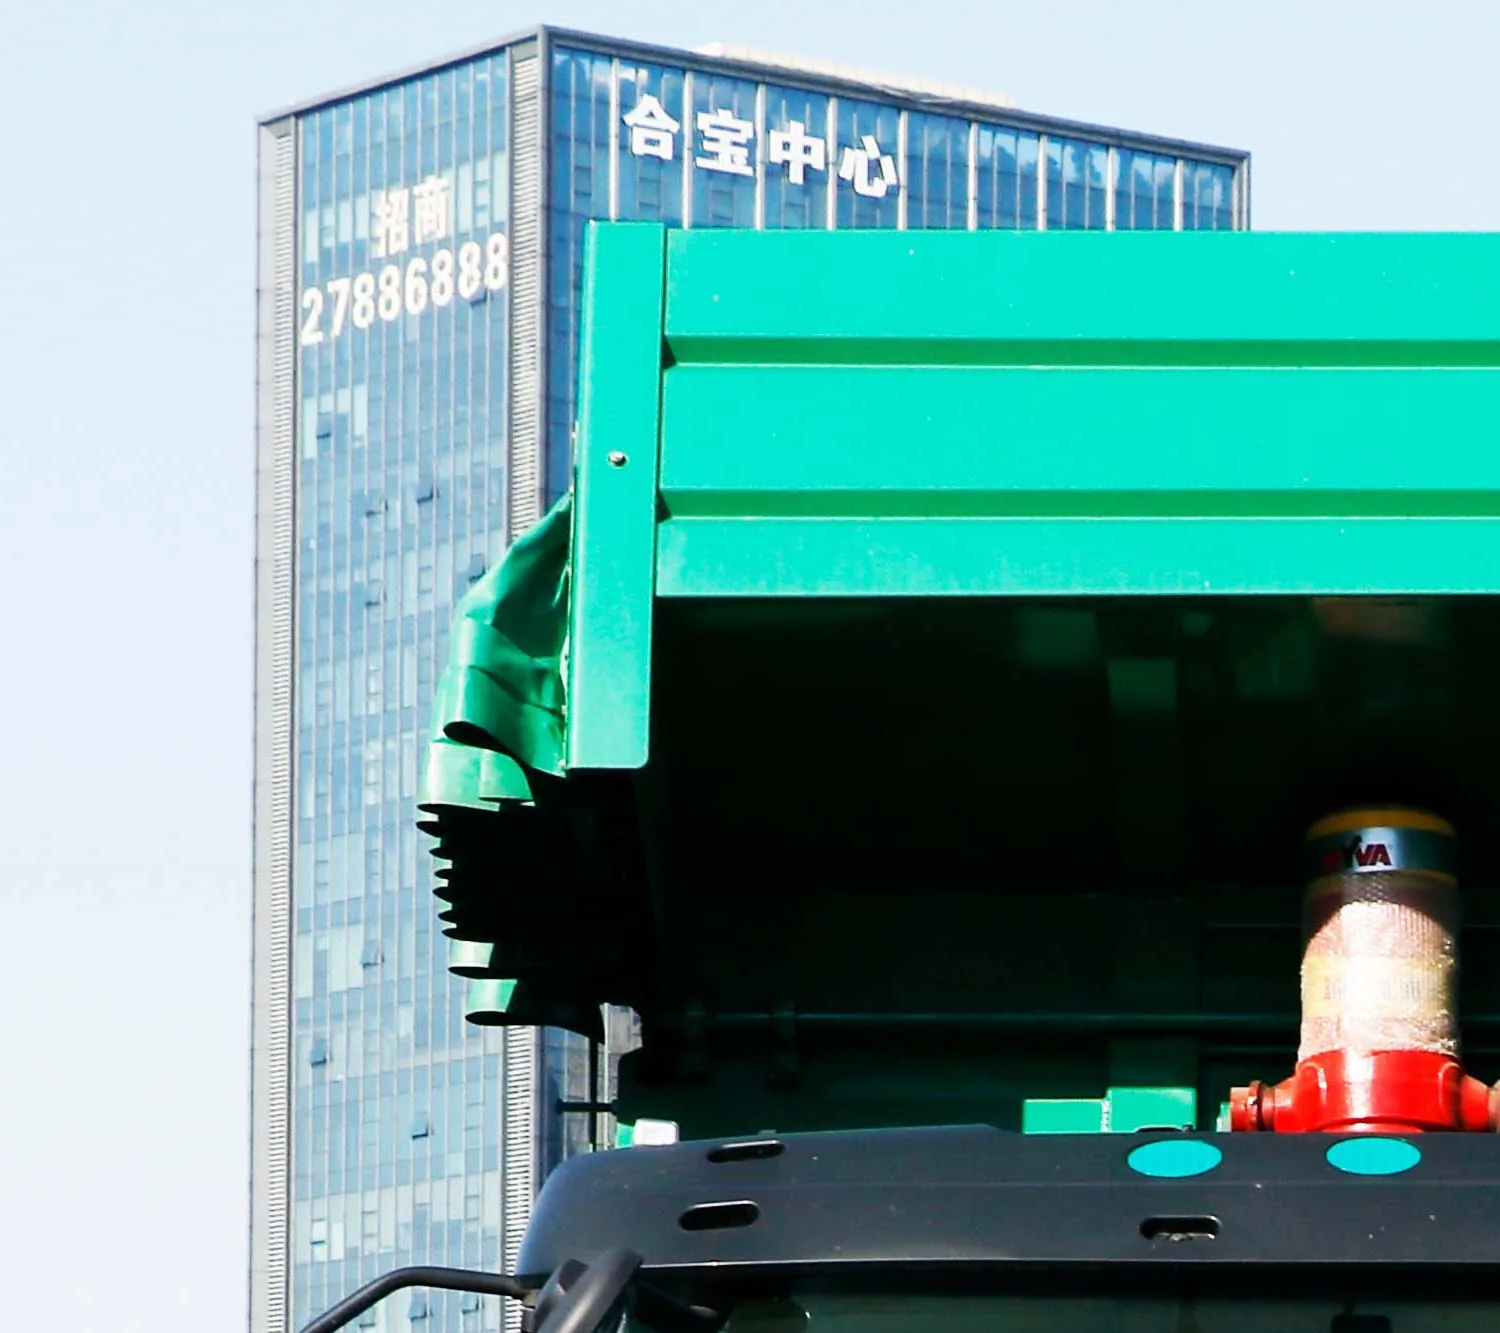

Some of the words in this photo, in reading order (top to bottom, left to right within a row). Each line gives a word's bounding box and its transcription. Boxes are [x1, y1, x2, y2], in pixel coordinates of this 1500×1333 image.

[622, 93, 898, 198] 合宝中心
[372, 175, 449, 259] 招商
[300, 232, 509, 346] 27886888
